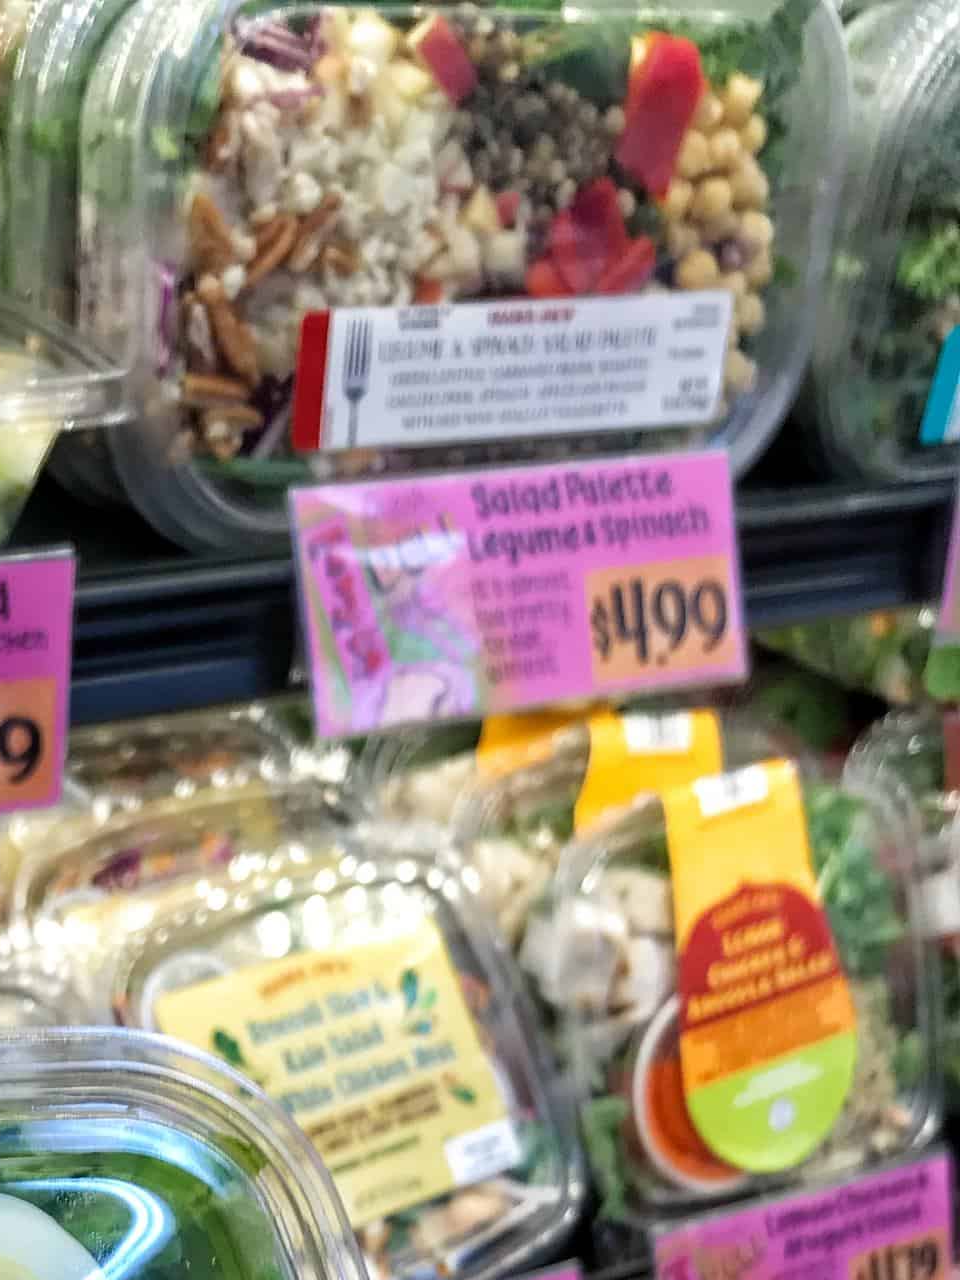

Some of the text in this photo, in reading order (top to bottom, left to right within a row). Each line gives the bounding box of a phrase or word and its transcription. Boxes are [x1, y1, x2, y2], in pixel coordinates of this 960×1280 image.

[470, 478, 561, 518] Salad
[564, 470, 673, 505] Palette
[467, 526, 579, 566] Legume
[599, 504, 710, 548] Spinach
[590, 574, 728, 668] $4.99
